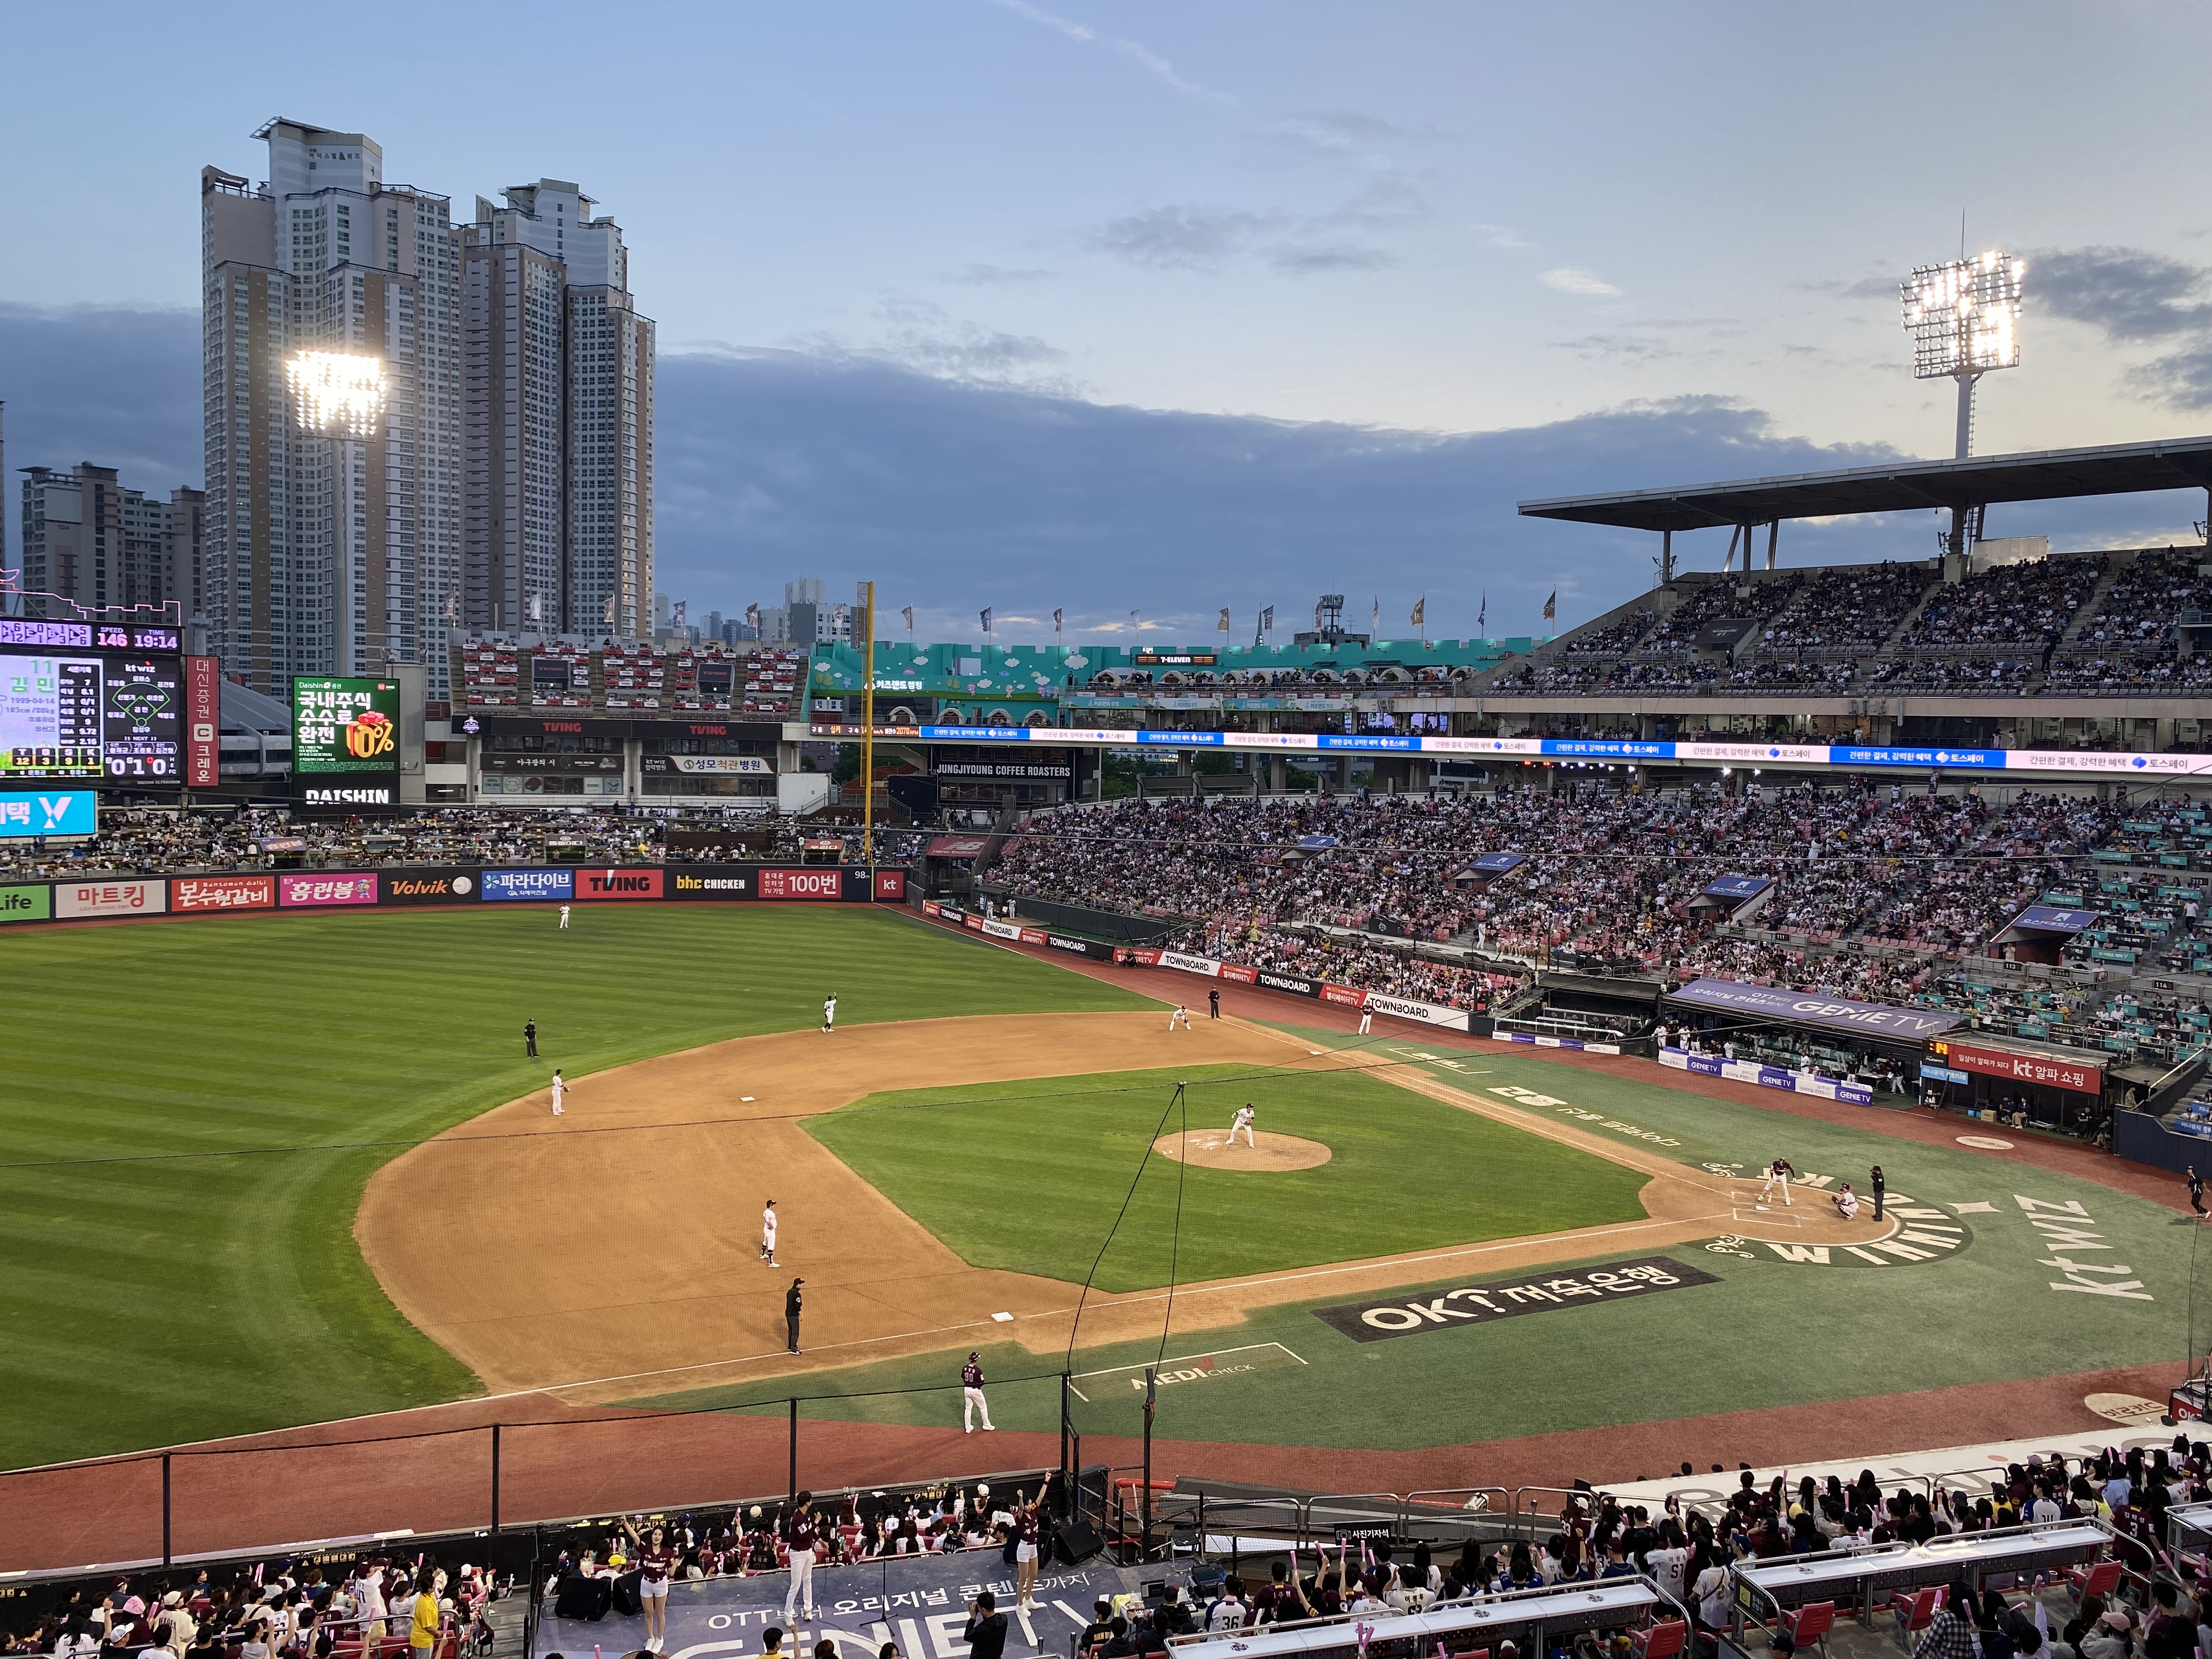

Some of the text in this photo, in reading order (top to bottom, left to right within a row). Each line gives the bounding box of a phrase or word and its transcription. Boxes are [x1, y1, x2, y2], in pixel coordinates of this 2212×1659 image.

[12, 634, 22, 642] 12
[97, 633, 128, 646] 146
[134, 635, 177, 648] 19:14
[31, 660, 50, 673] 11
[196, 660, 210, 719] 대신증권
[876, 680, 922, 690] 키즈랜드 캠핑
[298, 691, 371, 710] 국내주식
[298, 709, 353, 726] 수수료
[543, 721, 582, 732] TVING
[690, 725, 726, 735] TVING
[298, 726, 335, 744] 완전
[1694, 747, 1712, 755] 간편한
[1714, 747, 1729, 756] 결제,
[1730, 748, 1750, 757] 강력한
[1781, 749, 1810, 758] 토스페이
[1849, 751, 1984, 763] 간편한 결제, 강력한 혜택 토스페이
[111, 759, 126, 775] 0
[133, 759, 145, 775] 1
[152, 759, 166, 775] 0
[196, 746, 210, 782] 크레온
[517, 758, 555, 766] 야구광의 시
[2030, 756, 2188, 769] 간편한 결제, 강력한 혜택 토스페이
[936, 764, 1070, 777] JUNGJIYOUNG COFFEE ROASTERS
[306, 789, 388, 804] DAISHIN
[0, 802, 30, 826] 택
[500, 873, 571, 889] 파라다이브
[589, 870, 650, 891] TVING
[676, 875, 745, 889] bhc CHICKEN
[855, 871, 870, 879] 98m
[290, 881, 354, 901] 홈런볼
[390, 879, 449, 895] Volvik
[788, 874, 836, 895] 100번
[883, 879, 896, 890] kt
[1709, 887, 1754, 895] 오산대학교
[0, 894, 32, 910] ife
[77, 885, 144, 908] 마트킹
[178, 882, 268, 907] 본수원갈비
[2020, 918, 2081, 929] 오산대학교
[1049, 936, 1086, 951] TOWNBOARD
[1165, 955, 1209, 972] TOWNBOARD
[1260, 974, 1310, 993] TOWNBOARD
[1327, 992, 1358, 1006] 엘리베이터TV
[1691, 987, 1785, 1008] 오리지널 콘텐츠까지
[1752, 991, 1793, 1004] OTT부터
[1369, 997, 1429, 1019] TOWNBOARD
[1792, 1001, 1940, 1030] GENIE TV
[1691, 1062, 1718, 1073] GENIE TV
[1958, 1054, 1976, 1064] 일상이
[1996, 1062, 2010, 1070] 되다
[2013, 1059, 2033, 1078] kt
[2035, 1066, 2059, 1081] 알파
[2060, 1073, 2084, 1087] 쇼핑
[1763, 1076, 1791, 1087] GENIE TV
[1840, 1091, 1861, 1101] GENIE
[1505, 1265, 1681, 1304] 저축은행
[1352, 1528, 1389, 1539] 사진기자석
[1561, 1519, 1571, 1537] 33
[2130, 1521, 2138, 1538] 3
[833, 1587, 950, 1617] 오리지널
[1222, 1615, 1240, 1630] 36
